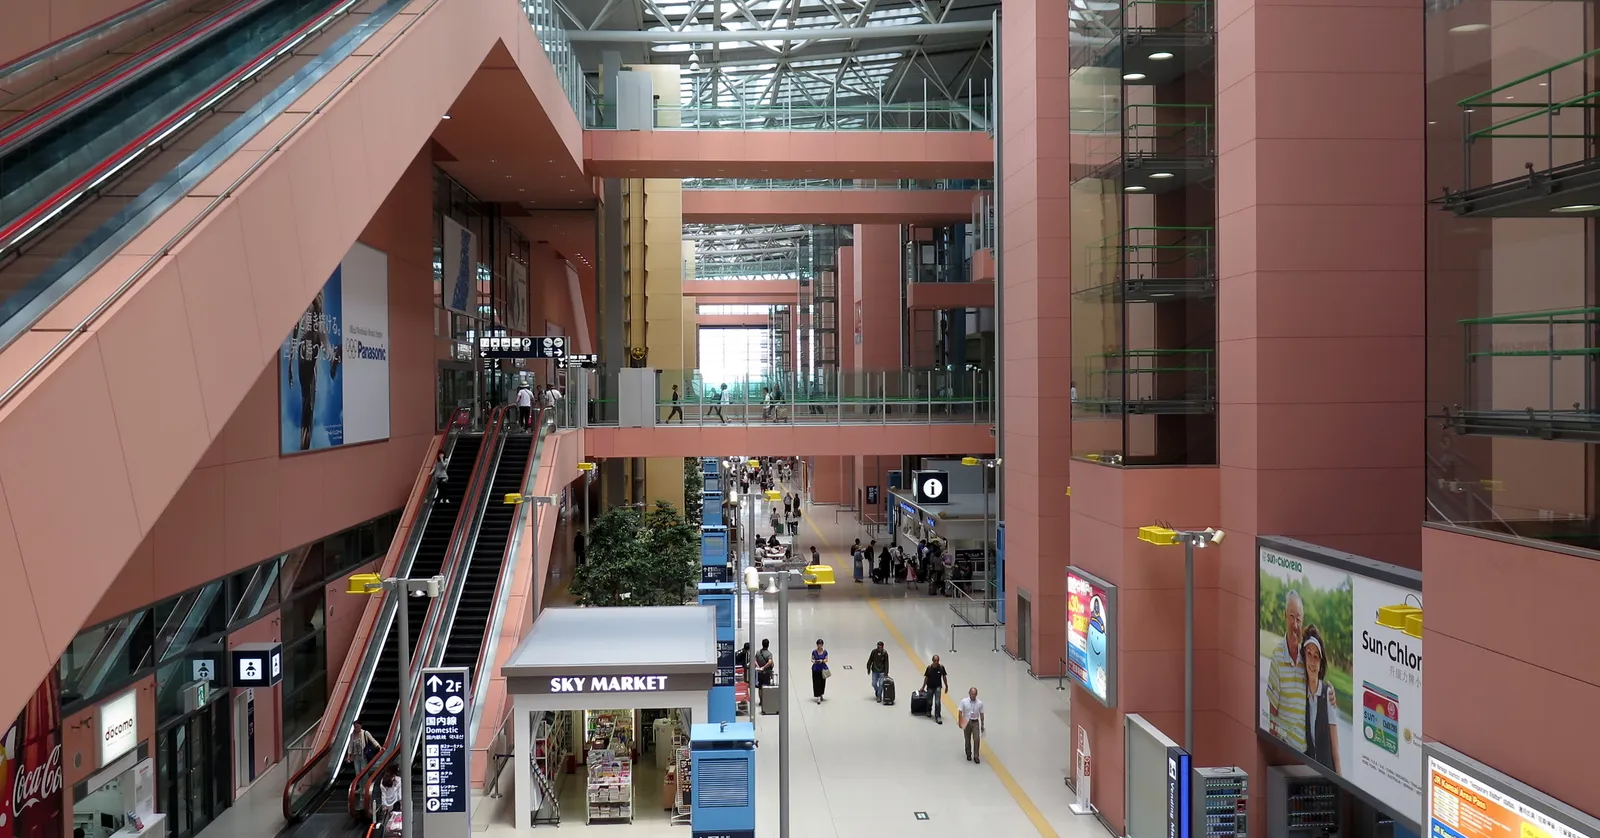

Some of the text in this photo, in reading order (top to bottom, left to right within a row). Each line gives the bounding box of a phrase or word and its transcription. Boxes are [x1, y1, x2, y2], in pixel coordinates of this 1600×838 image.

[358, 341, 386, 360] Panasonic
[445, 680, 462, 692] 2F
[551, 676, 668, 692] SKY MARKET
[426, 716, 457, 726] 国内線
[105, 718, 133, 741] docomo
